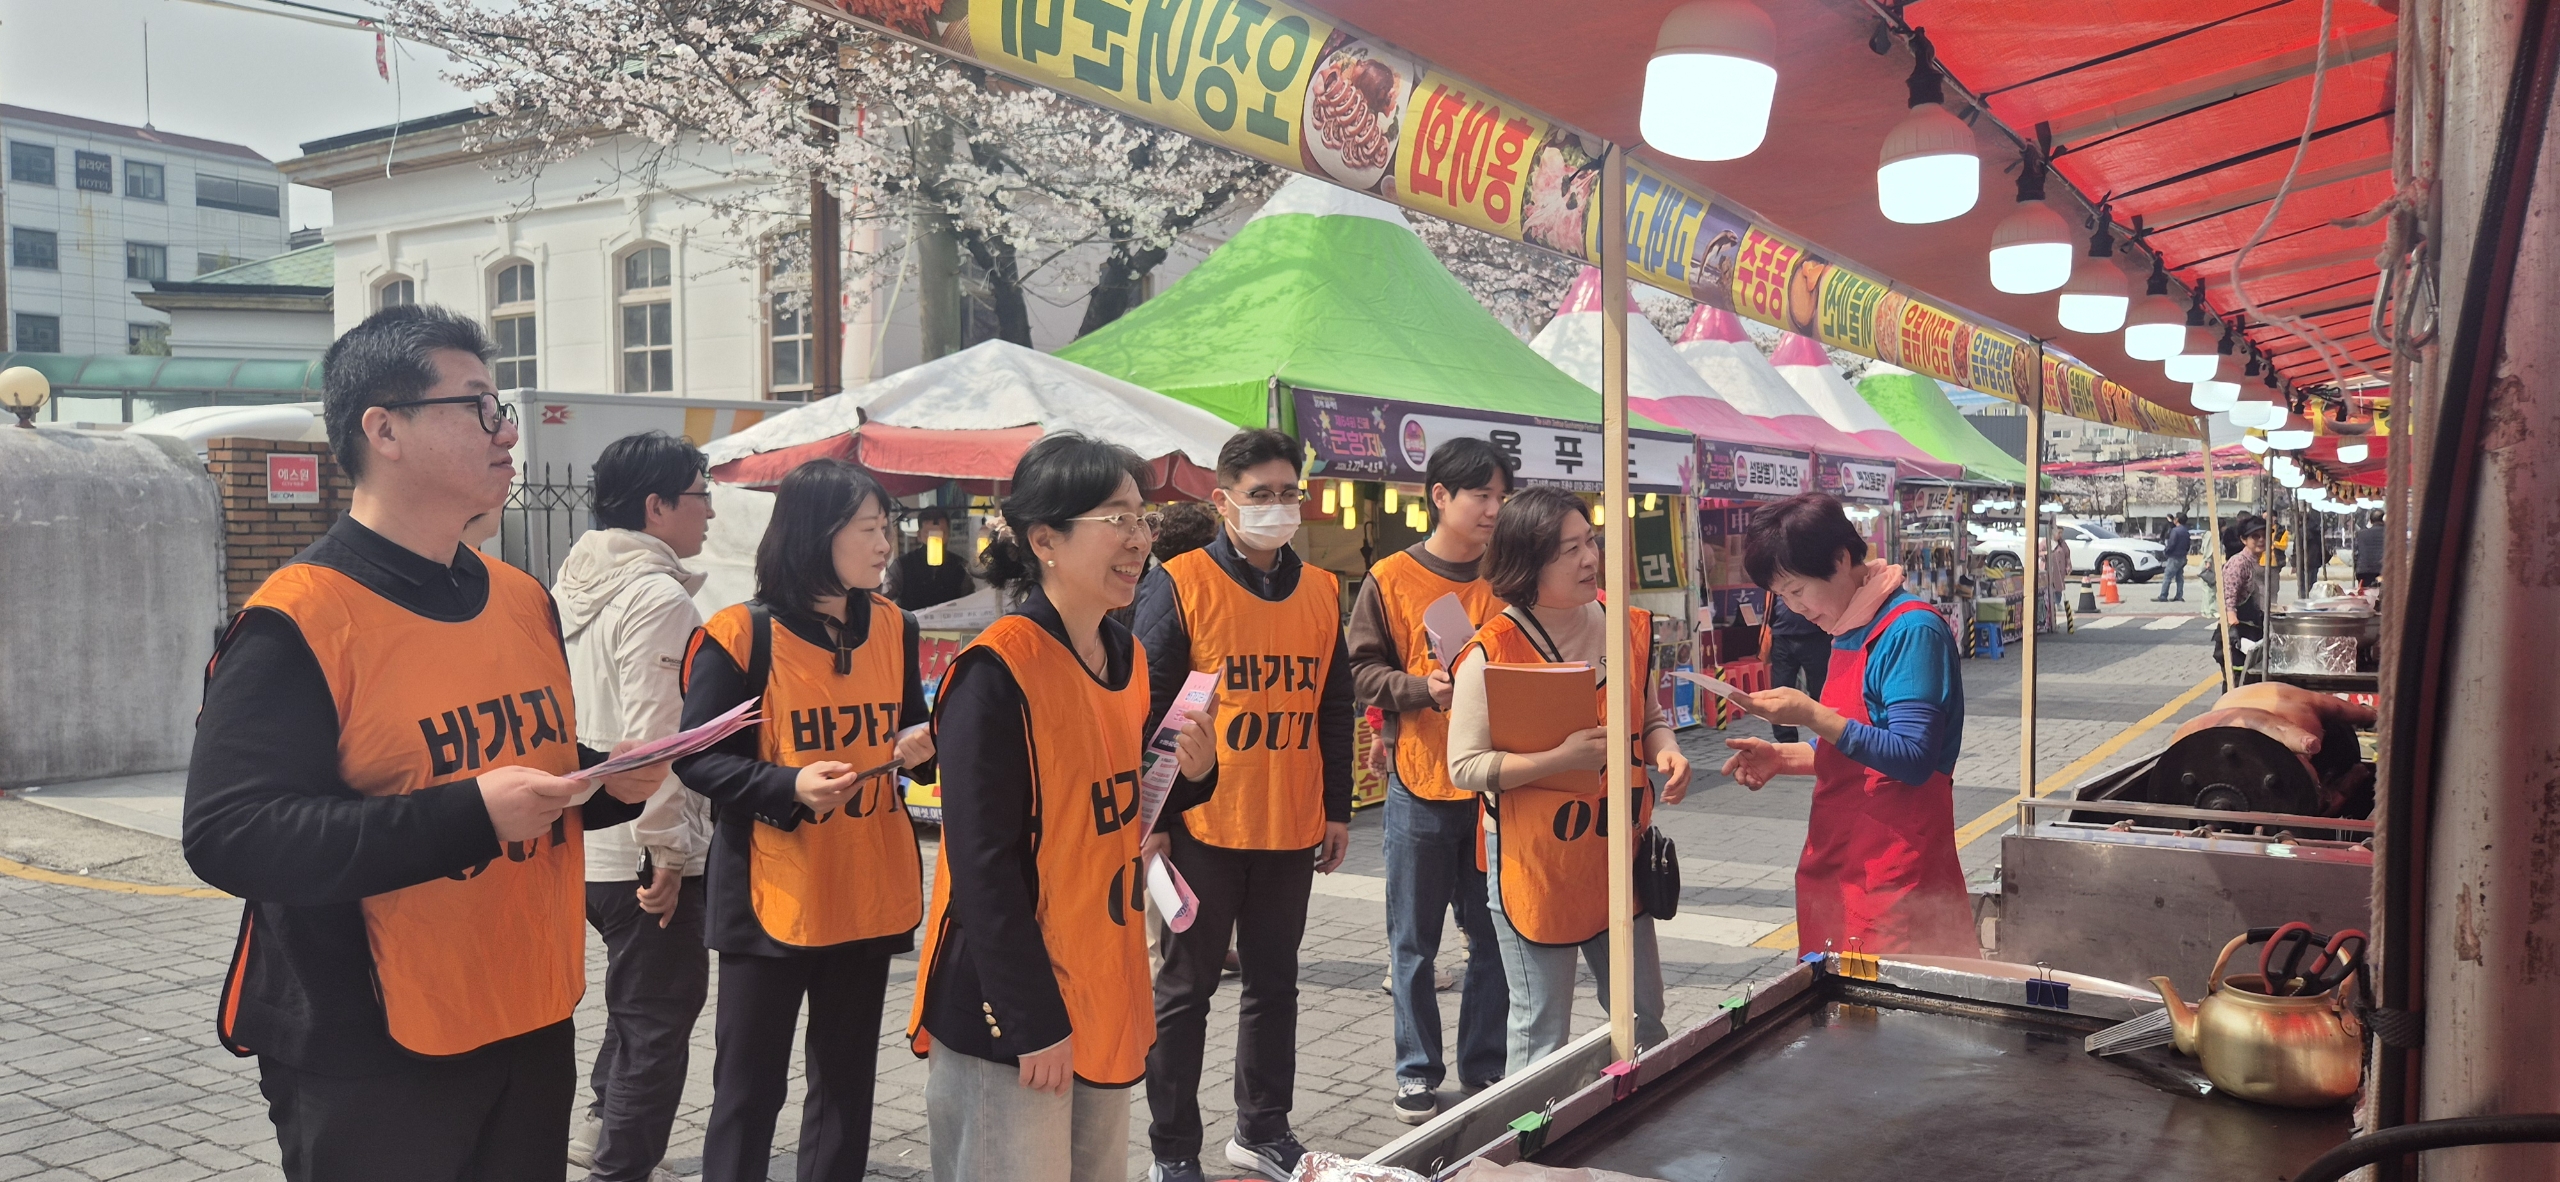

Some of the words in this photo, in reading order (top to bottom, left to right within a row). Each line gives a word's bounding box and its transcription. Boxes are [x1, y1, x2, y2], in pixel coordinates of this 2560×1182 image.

[79, 177, 112, 191] HOTEL
[1330, 429, 1383, 458] 군항제
[1554, 435, 1583, 475] 푸
[277, 467, 309, 482] 에스원
[1779, 464, 1798, 488] 장난감
[1226, 654, 1320, 693] 바가지
[418, 685, 568, 777] 바가지
[791, 702, 901, 752] 바가지
[1226, 711, 1315, 751] OUT
